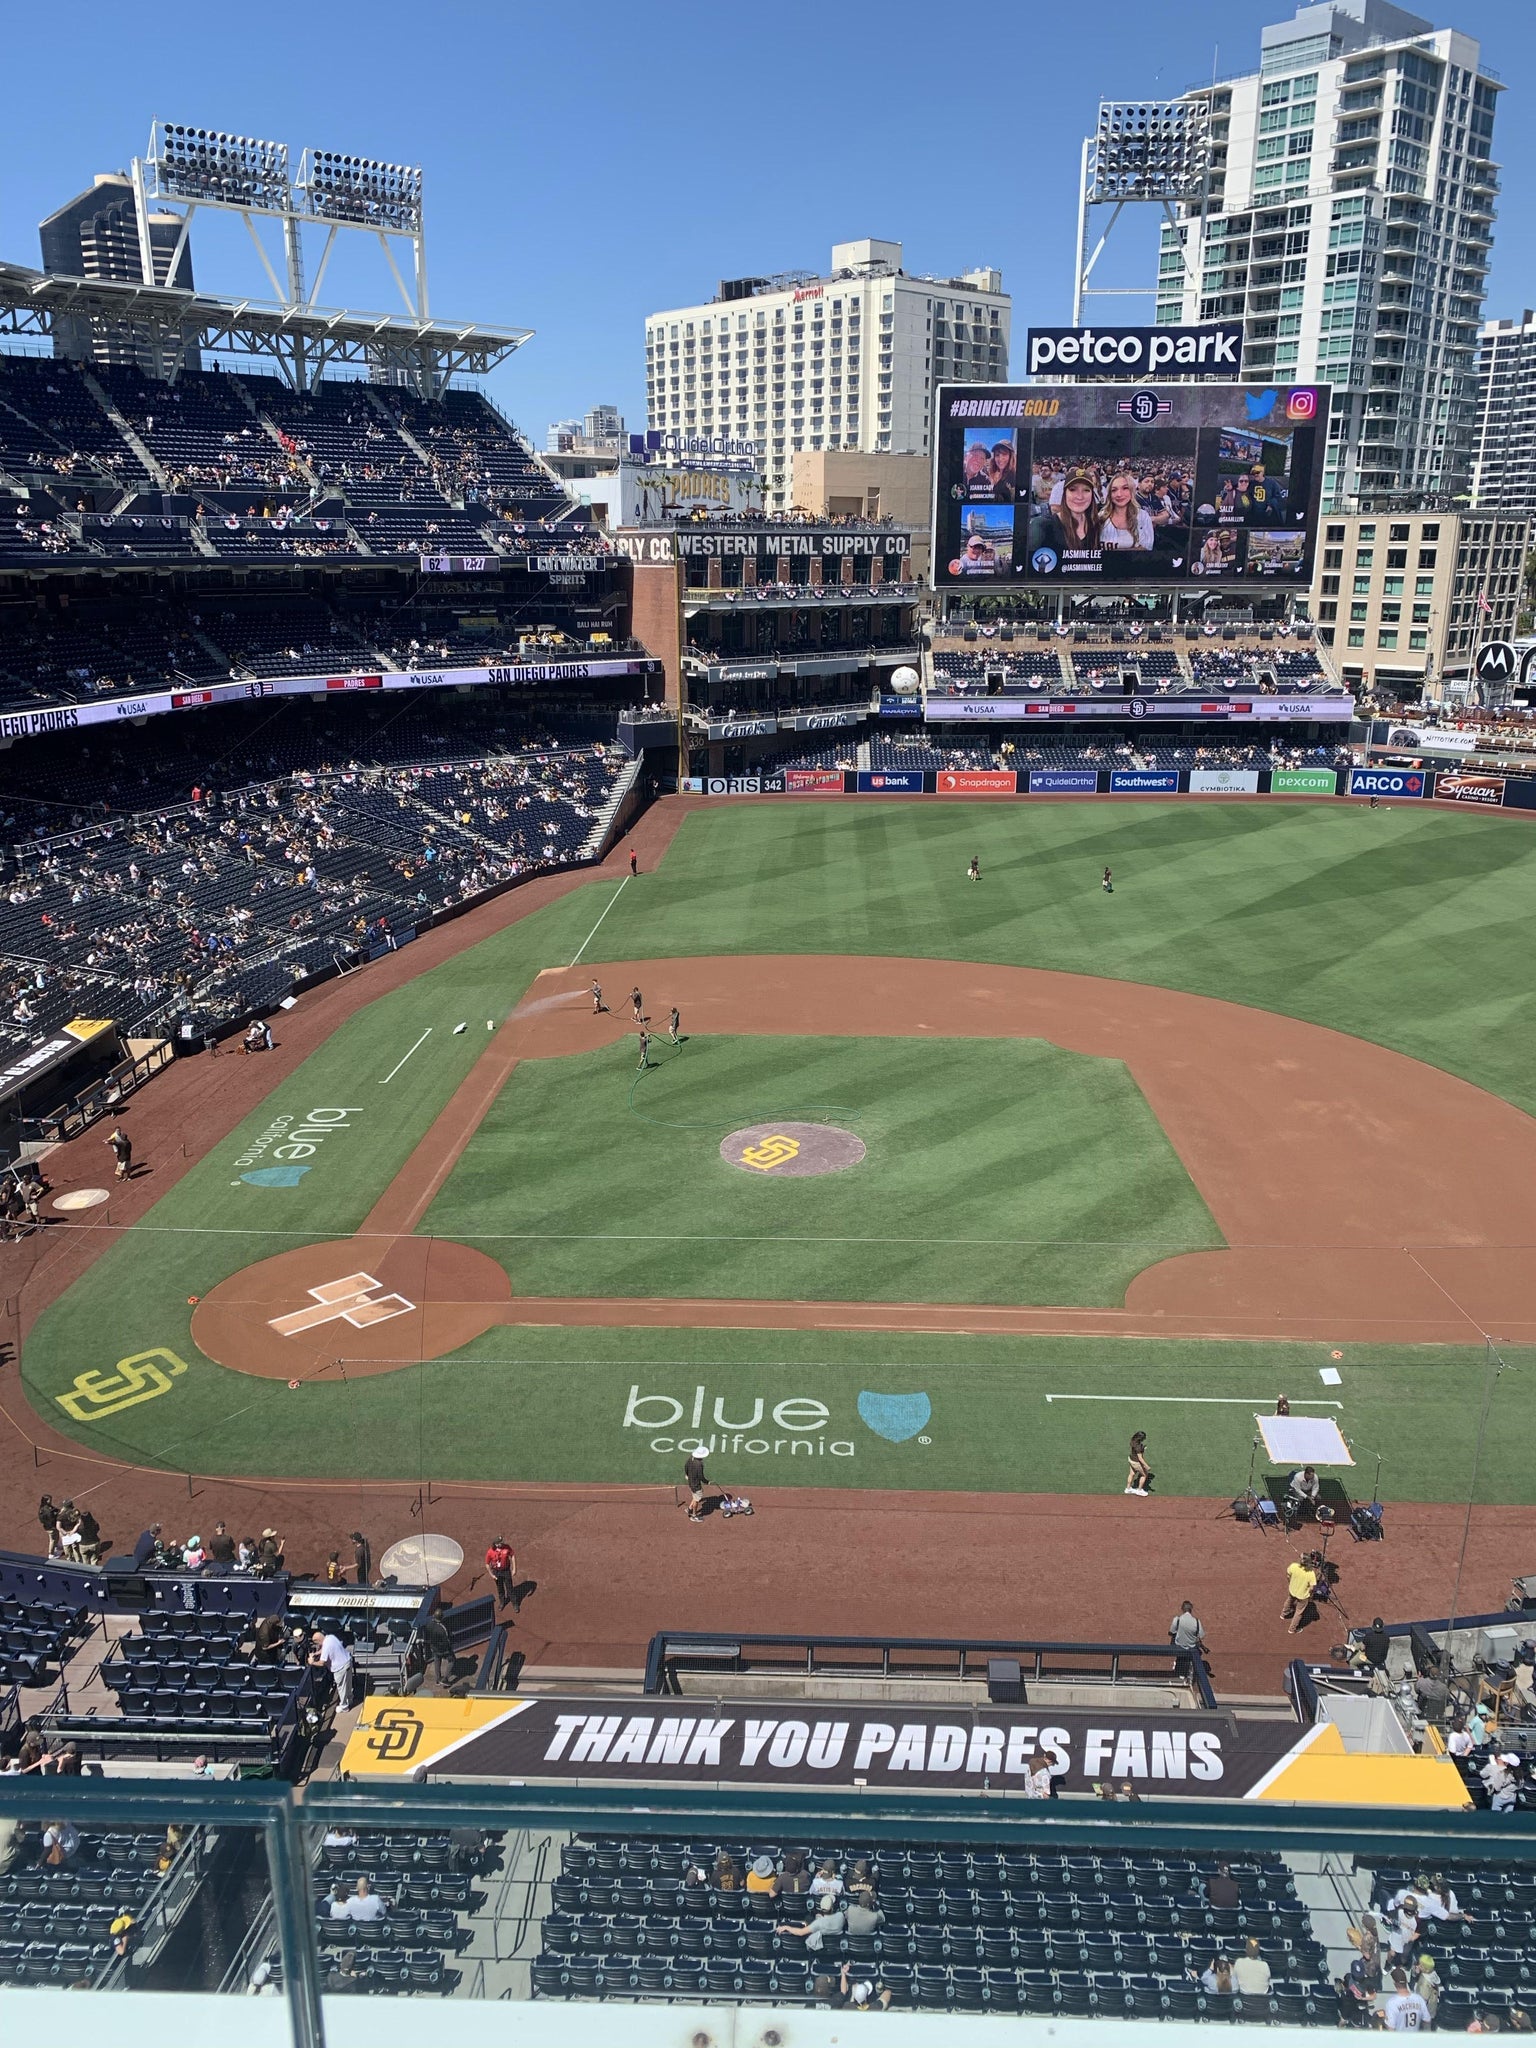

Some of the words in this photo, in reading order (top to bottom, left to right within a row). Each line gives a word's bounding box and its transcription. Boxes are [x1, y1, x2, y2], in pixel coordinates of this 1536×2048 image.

[1031, 330, 1142, 372] petco
[1149, 332, 1239, 371] park
[950, 399, 1060, 417] #BRINGTHEGOLD
[665, 434, 753, 455] QuidelOrtho
[670, 472, 730, 504] PADRES
[650, 538, 674, 561] CO.
[677, 535, 758, 555] WESTERN
[766, 536, 818, 555] METAL
[823, 536, 880, 555] SUPPLY
[886, 537, 910, 555] CO.
[1062, 550, 1089, 559] JASMINE
[1090, 550, 1102, 559] LEE
[462, 558, 486, 570] 12:27
[538, 557, 598, 571] CUTWATER
[550, 574, 586, 585] SPIRITS
[421, 675, 444, 685] USAA
[488, 668, 510, 683] SAN
[514, 665, 546, 682] DIEGO
[550, 664, 589, 680] PADRES
[343, 678, 366, 688] PADRES
[182, 696, 191, 705] SAN
[191, 694, 203, 703] DIEGO
[127, 703, 147, 715] USAA
[974, 705, 995, 714] USAA
[1038, 705, 1049, 713] SAN
[1049, 705, 1065, 713] DIEGO
[1289, 704, 1311, 713] USAA
[33, 709, 78, 733] PADRES
[710, 778, 758, 793] ORIS
[764, 779, 782, 791] 342
[960, 778, 1011, 788] Snapdragon
[1045, 777, 1094, 786] QuidelOrtho
[1114, 777, 1167, 786] Southwest
[1353, 776, 1404, 791] ARCO
[1438, 777, 1497, 799] Sycuan
[232, 1115, 294, 1166] california
[273, 1108, 363, 1159] blue
[622, 1385, 830, 1431] blue
[650, 1434, 855, 1456] california
[337, 1597, 377, 1606] PADRES
[543, 1715, 735, 1766] THANK
[739, 1718, 850, 1768] YOU
[853, 1723, 1071, 1776] PADRES
[1083, 1729, 1224, 1781] FANS
[1405, 2012, 1417, 2028] 13
